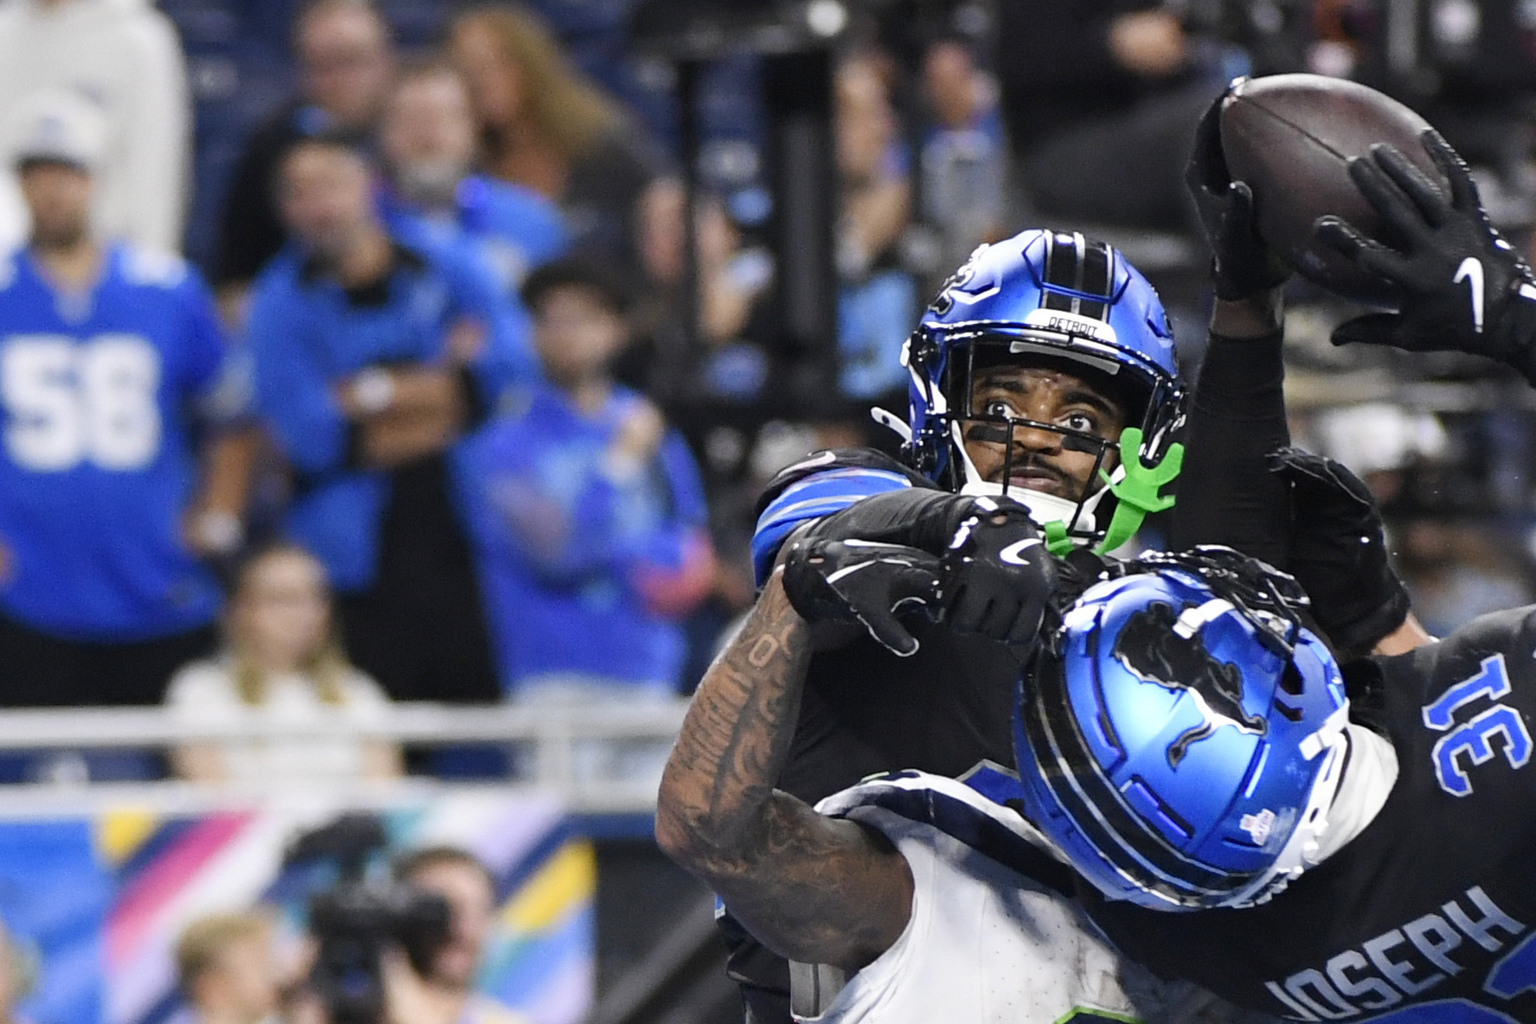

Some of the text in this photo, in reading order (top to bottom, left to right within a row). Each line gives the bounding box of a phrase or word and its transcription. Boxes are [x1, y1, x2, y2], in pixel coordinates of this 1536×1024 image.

[1048, 317, 1098, 337] DETROIT
[0, 332, 163, 473] 58
[1421, 652, 1534, 797] 31
[1264, 885, 1527, 1024] JOSEPH
